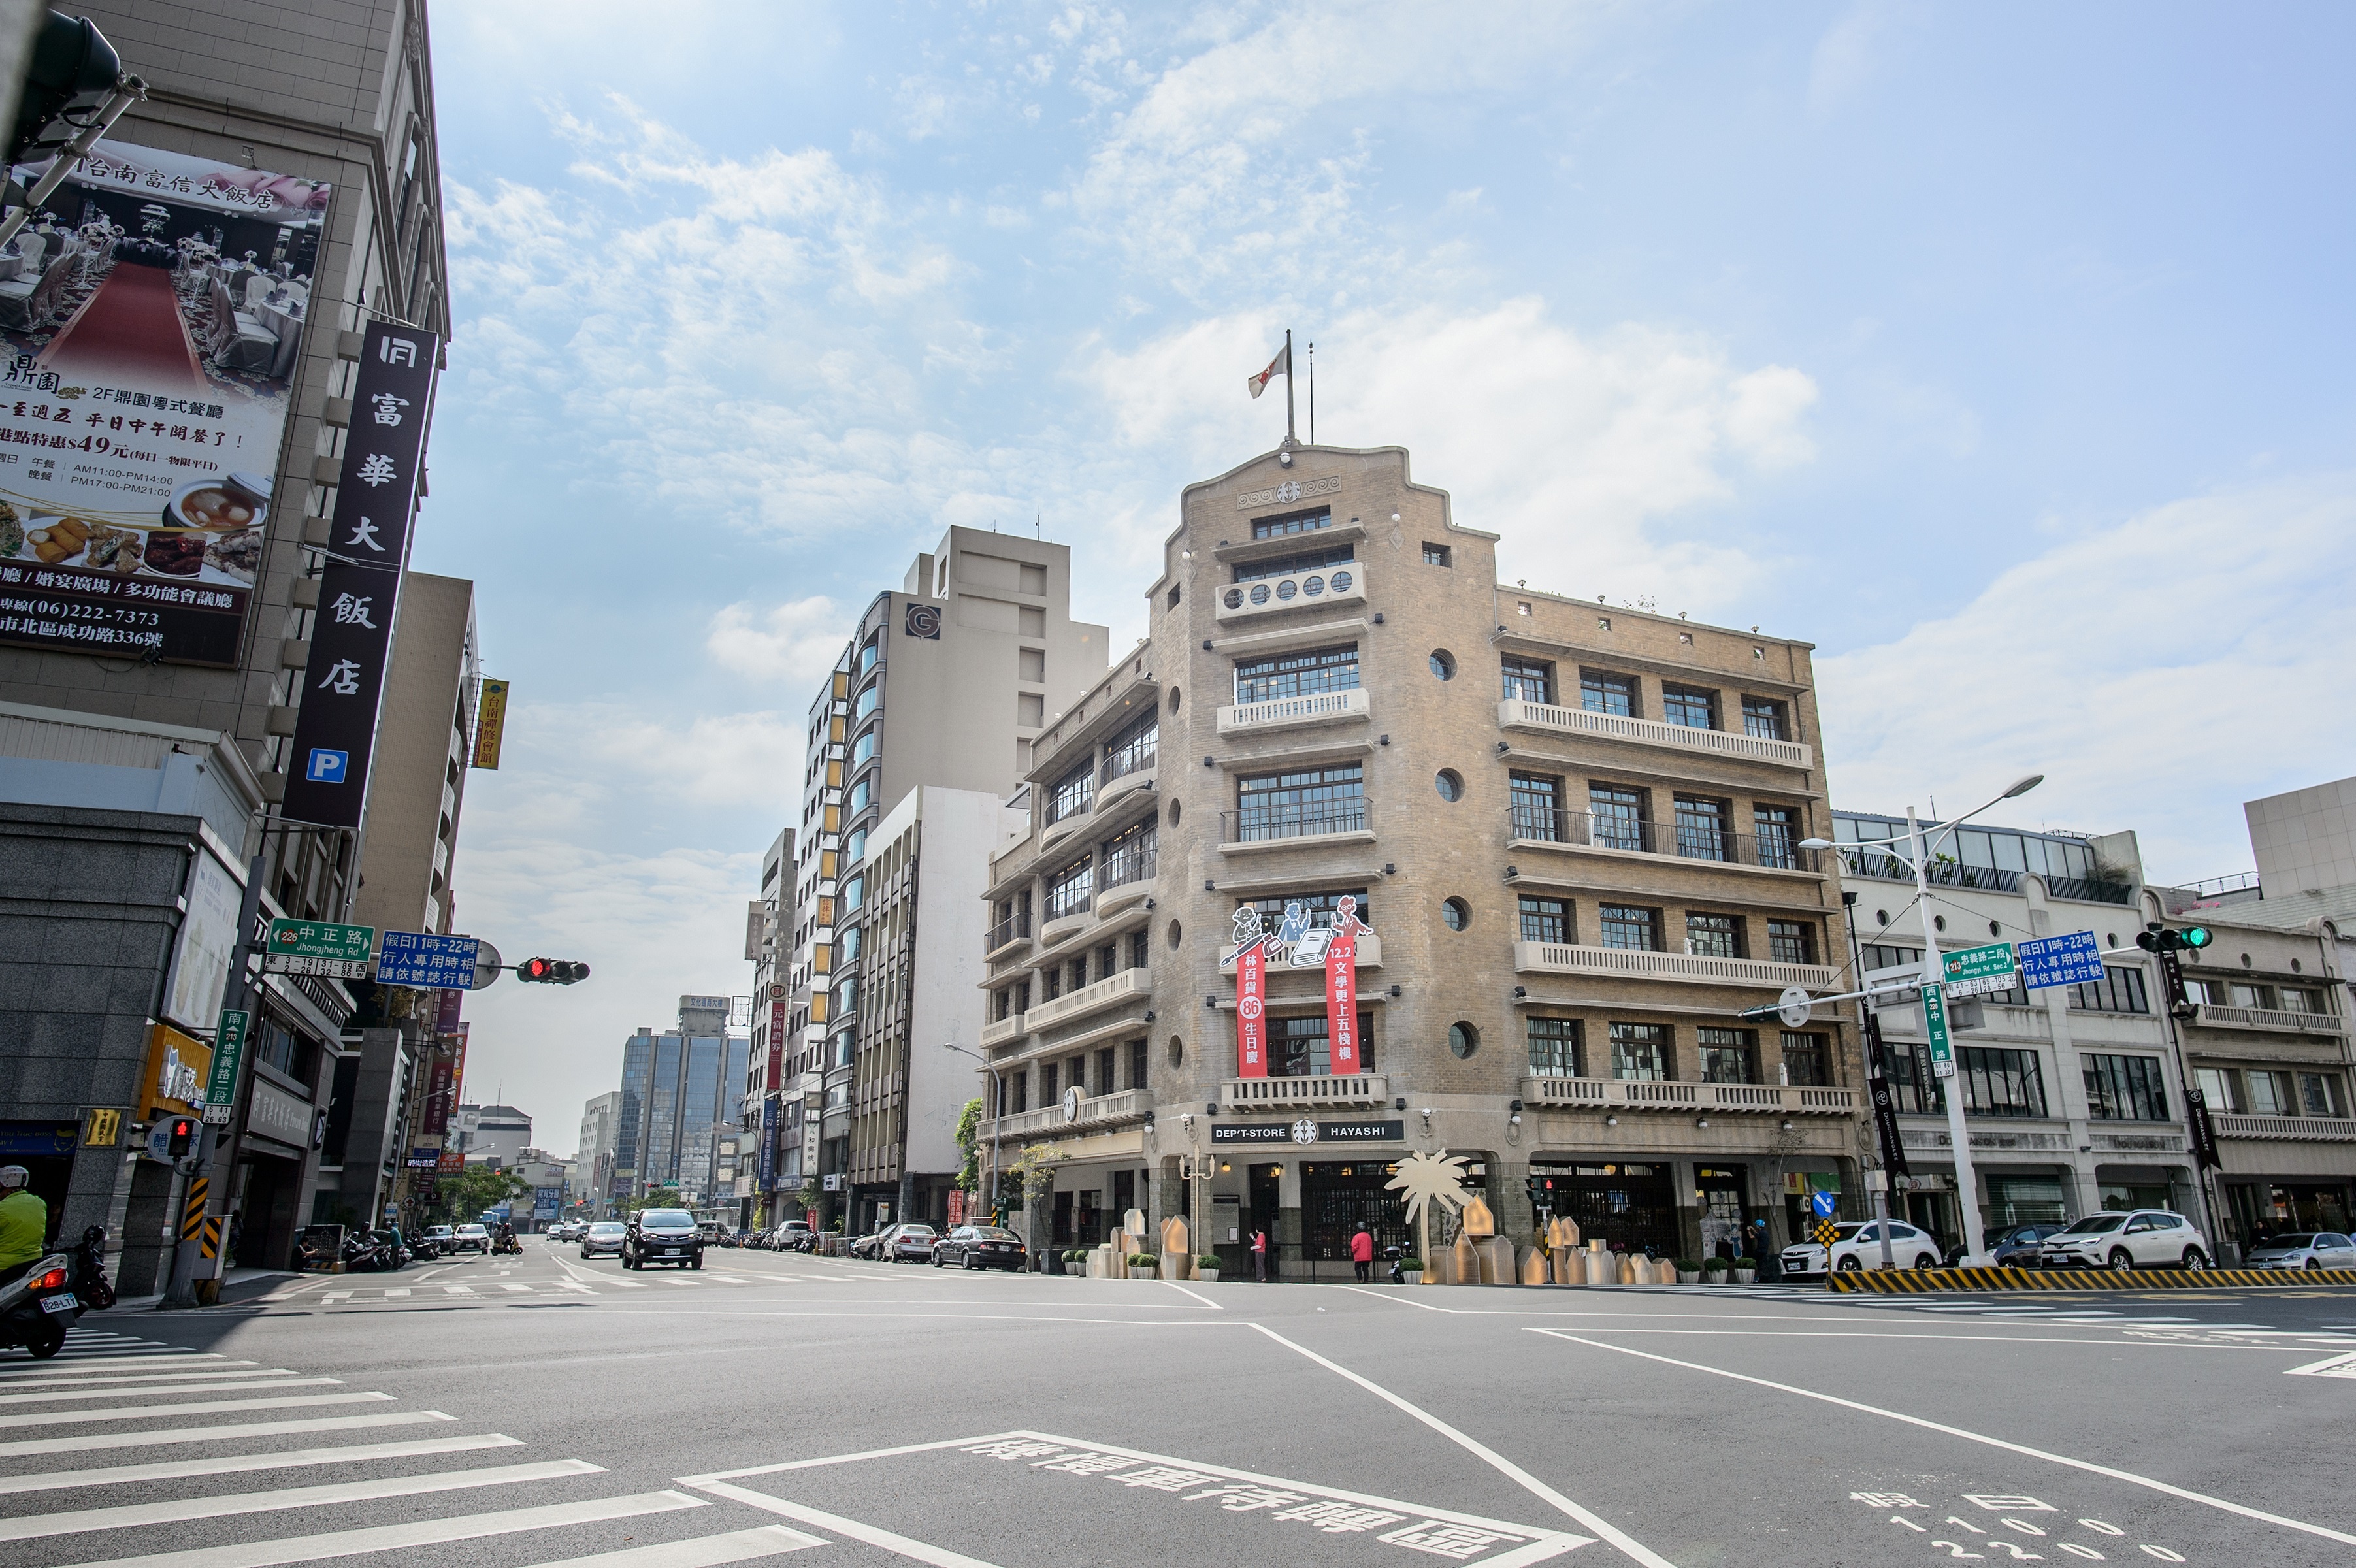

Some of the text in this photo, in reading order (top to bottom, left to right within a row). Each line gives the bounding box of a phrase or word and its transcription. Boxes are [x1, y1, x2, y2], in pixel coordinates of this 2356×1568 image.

[90, 159, 274, 210] 台南富信大飯店
[2, 354, 60, 394] 鼎園
[93, 387, 225, 419] 2F鼎園粵式餐廳
[32, 458, 56, 469] 午餐
[73, 464, 173, 485] AM11:00-PM14:00
[28, 470, 171, 497] 晚餐 PM17:00-PM21:00
[318, 392, 410, 696] 富華大飯店
[124, 582, 234, 609] 多功能會議廳
[480, 696, 499, 764] 台南禪修會館
[281, 930, 299, 943] 226
[299, 925, 363, 946] 中正路
[297, 942, 361, 956] Jhongjheng Rd.
[382, 951, 473, 970] 行人專用時相
[1330, 946, 1351, 959] 12.2
[1961, 948, 2006, 966] 忠義路二段
[2023, 949, 2099, 972] 行人專用時相
[267, 955, 277, 966] 東
[355, 962, 367, 973] 西
[1245, 954, 1257, 994] 林百貨
[1950, 962, 1961, 971] 213
[1963, 966, 1982, 975] Jhongyi
[2026, 964, 2102, 987] 請依號誌行駛
[378, 967, 471, 987] 請依號誌行駛
[1925, 987, 1937, 996] 西
[228, 1013, 242, 1024] 南
[1243, 1000, 1260, 1016] 86
[1334, 962, 1352, 1060] 文學更上五棧樓
[225, 1033, 237, 1041] 213
[770, 1009, 783, 1053] 元富證券
[1931, 1011, 1946, 1060] 中正路
[1245, 1022, 1258, 1065] 生日慶
[213, 1043, 235, 1102] 忠義路二段
[1216, 1126, 1384, 1138] DEP'T-STORE HAYASHI
[807, 1137, 815, 1162] 和興號
[44, 1298, 76, 1311] 828-LTY
